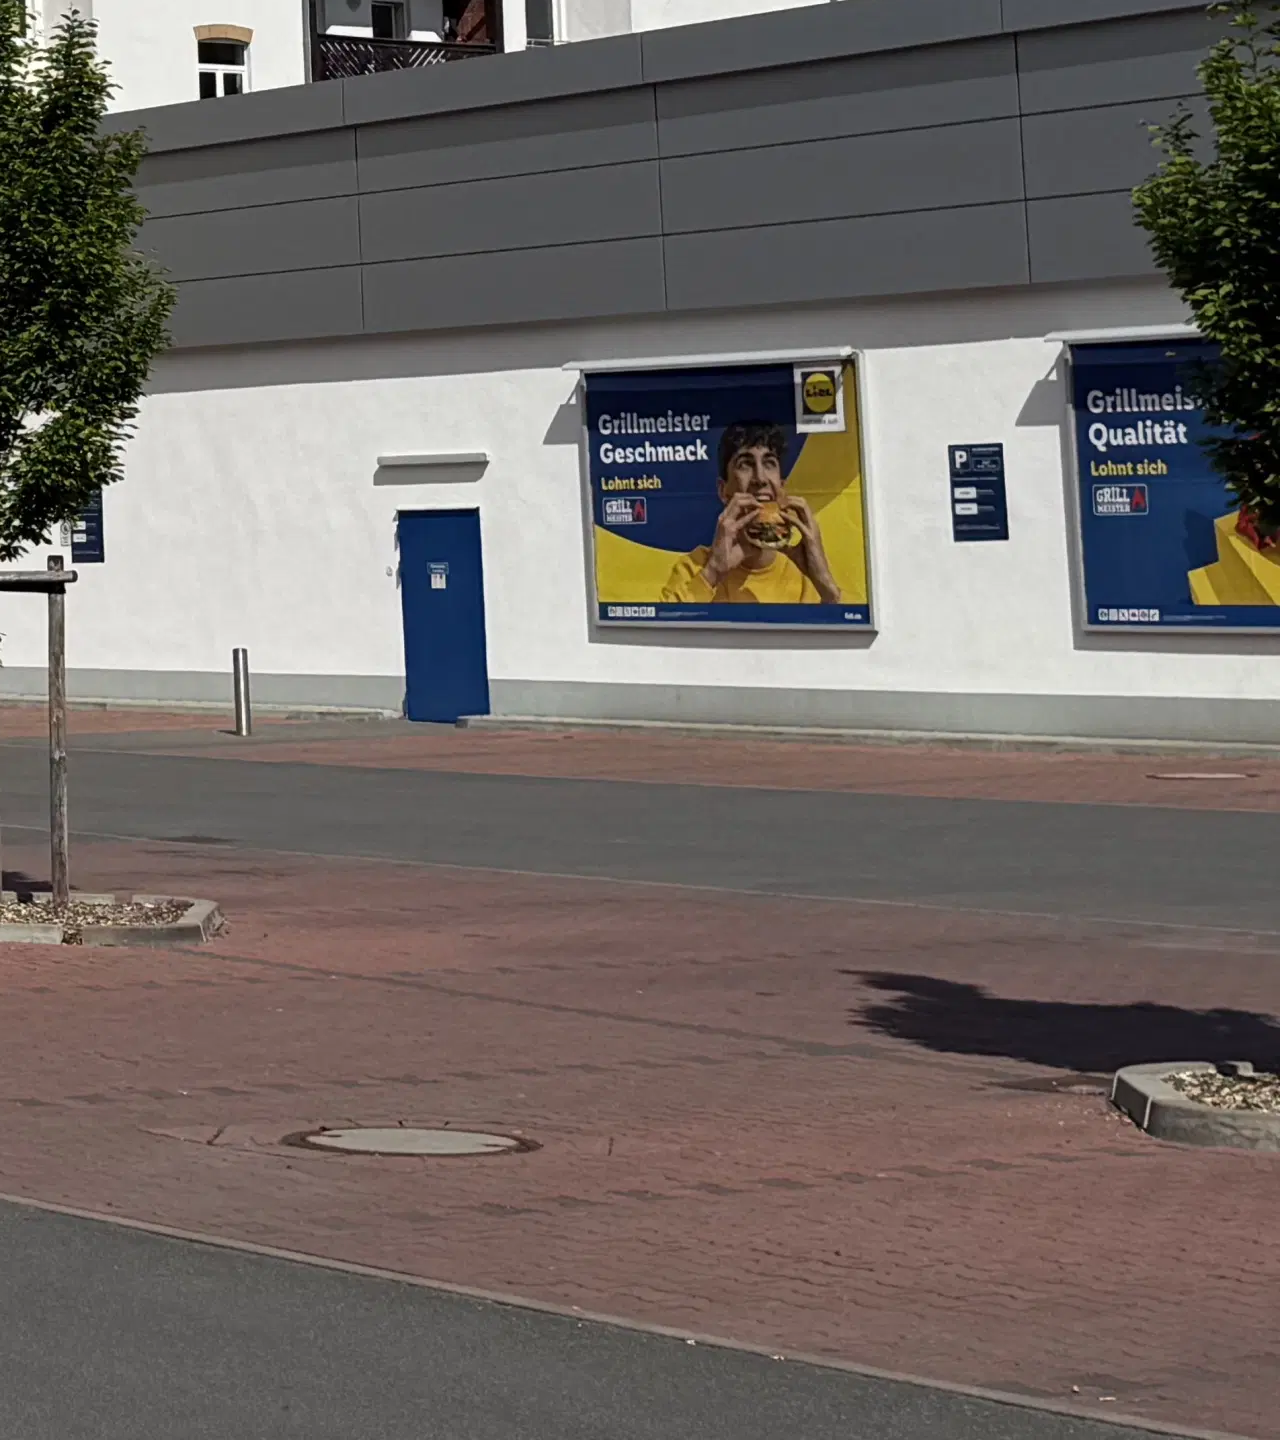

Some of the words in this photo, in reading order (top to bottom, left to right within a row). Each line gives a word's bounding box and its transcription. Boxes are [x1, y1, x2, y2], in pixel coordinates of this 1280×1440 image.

[1087, 385, 1202, 413] Grillmeis
[598, 410, 710, 435] Grillmeister
[1088, 420, 1187, 452] Qualität
[600, 439, 708, 464] Geschmack
[955, 451, 967, 468] P
[1091, 460, 1133, 476] Lohnt
[1136, 459, 1167, 475] sich
[601, 476, 635, 490] Lohnt
[638, 474, 661, 489] sich
[1096, 487, 1130, 502] GRILL
